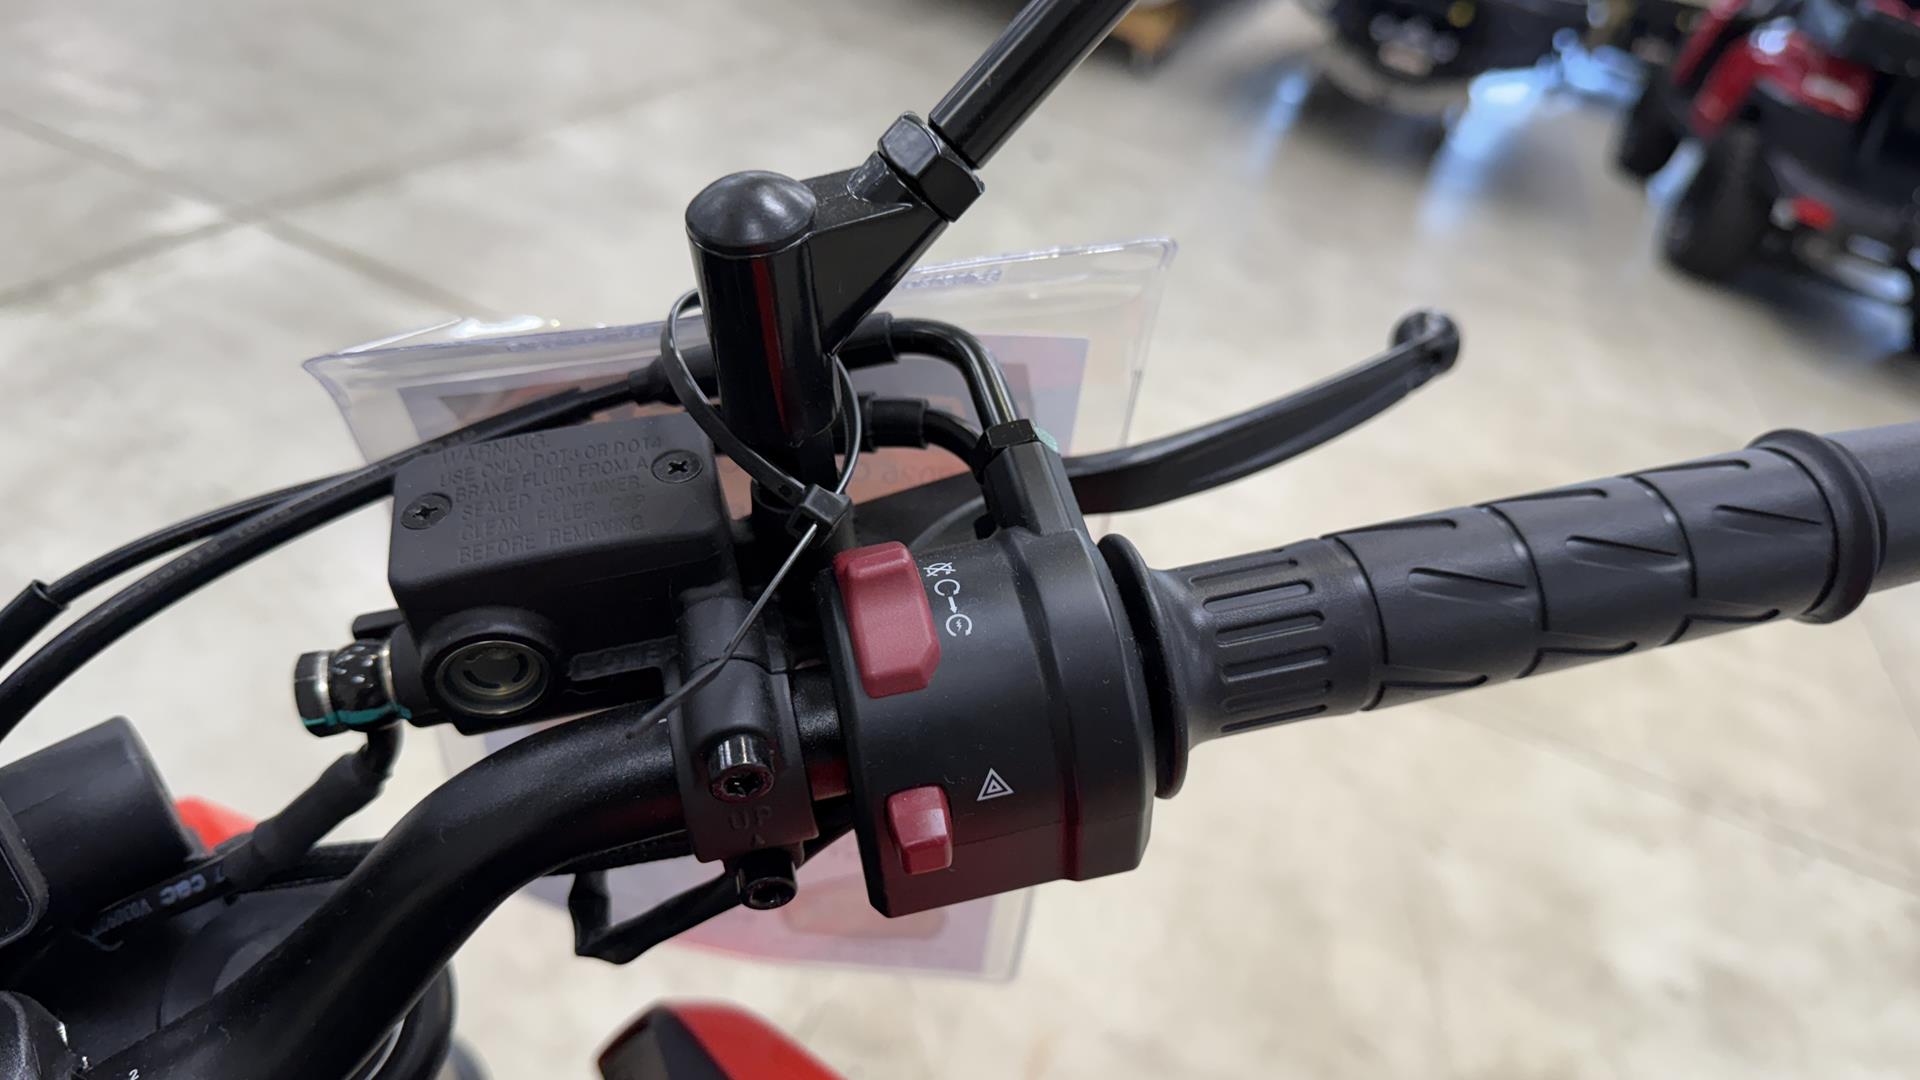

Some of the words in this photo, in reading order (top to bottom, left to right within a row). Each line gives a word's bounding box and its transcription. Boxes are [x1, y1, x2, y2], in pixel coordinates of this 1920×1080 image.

[440, 466, 475, 488] USE
[481, 458, 522, 479] ONLY
[584, 442, 608, 460] OR
[456, 476, 514, 503] BRAKE
[522, 465, 572, 489] FLUID
[578, 458, 629, 478] FROM
[637, 455, 649, 470] A
[462, 493, 531, 521] SEALED
[462, 516, 521, 541] CLEAN
[537, 500, 596, 524] FILLER
[459, 532, 536, 564] BEFORE
[549, 514, 644, 545] REMOVING
[728, 804, 773, 830] UP
